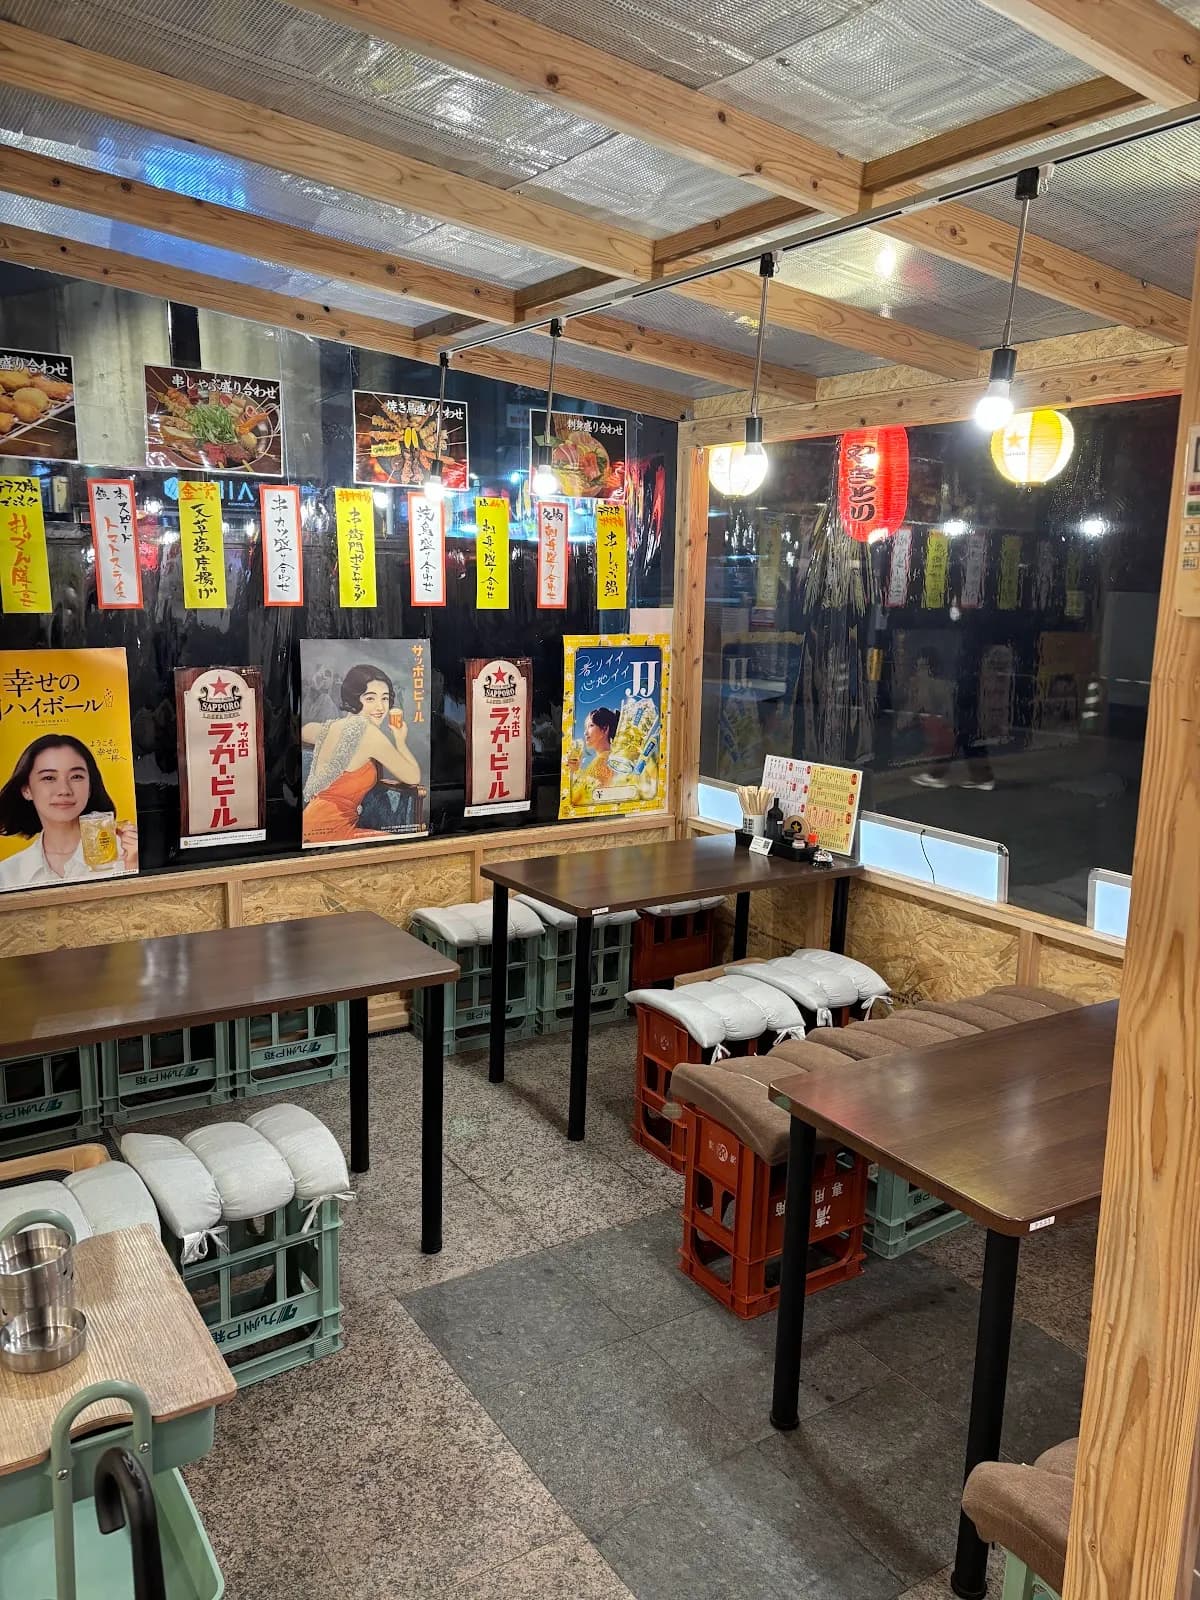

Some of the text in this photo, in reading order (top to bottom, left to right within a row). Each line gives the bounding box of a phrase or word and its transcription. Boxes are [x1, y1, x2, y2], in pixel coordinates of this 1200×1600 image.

[172, 373, 277, 399] 串しゃぶ盛り合わせ
[190, 503, 218, 599] 天草塩唐揚げ
[3, 668, 80, 698] 幸せの
[412, 645, 424, 723] サッポロビール
[625, 661, 659, 698] JJ
[0, 696, 104, 721] ハイボール
[201, 700, 240, 712] SAPPORO
[237, 722, 248, 758] サッポロ
[488, 707, 510, 799] ラガービール
[208, 723, 237, 828] ラガービール
